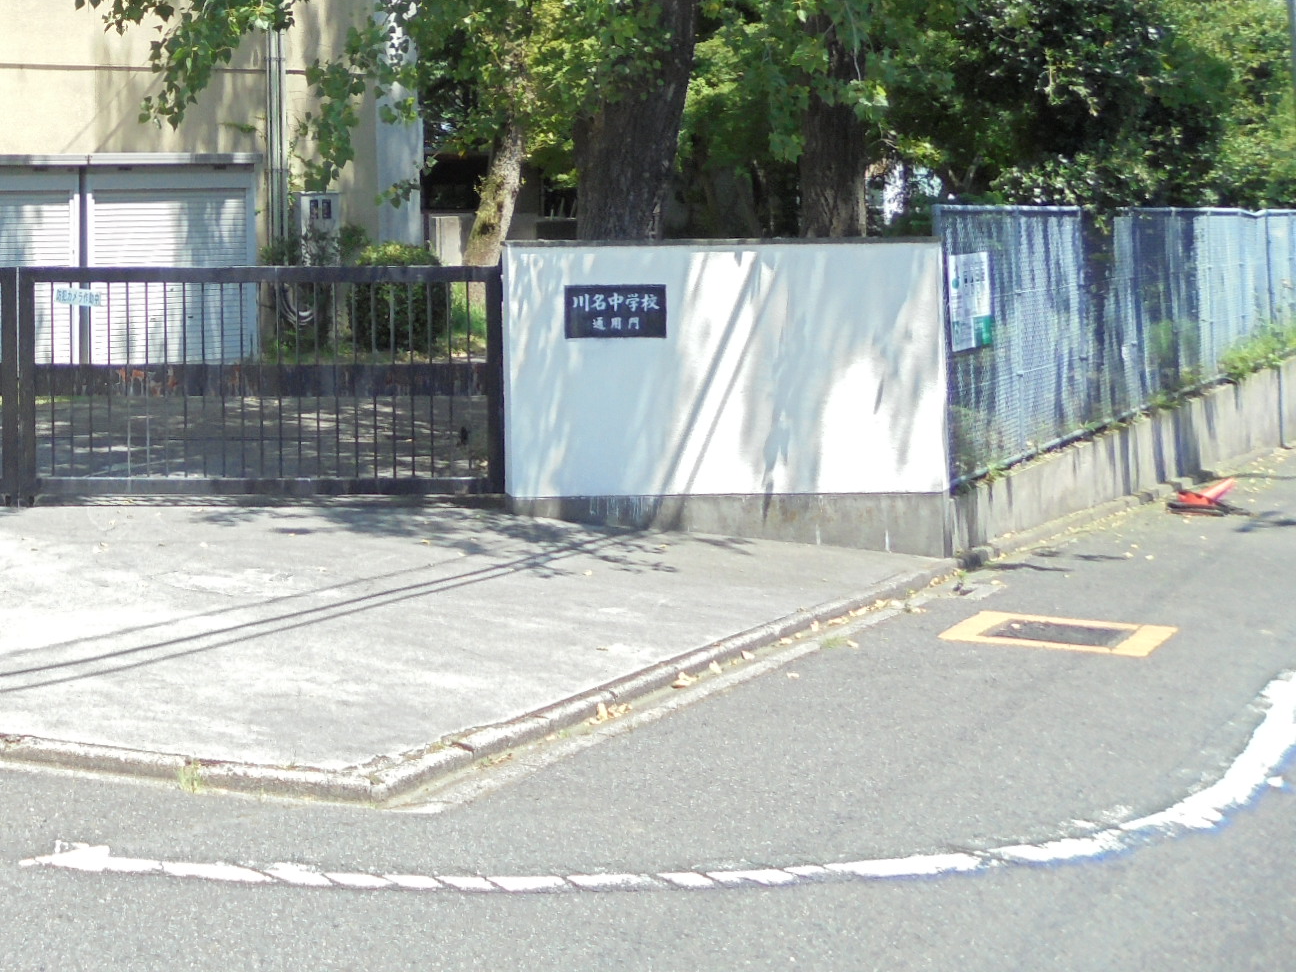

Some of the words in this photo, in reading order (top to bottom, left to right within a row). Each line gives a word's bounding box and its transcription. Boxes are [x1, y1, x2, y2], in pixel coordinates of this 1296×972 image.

[572, 292, 660, 312] 川名中学校
[592, 316, 640, 330] 通用門
